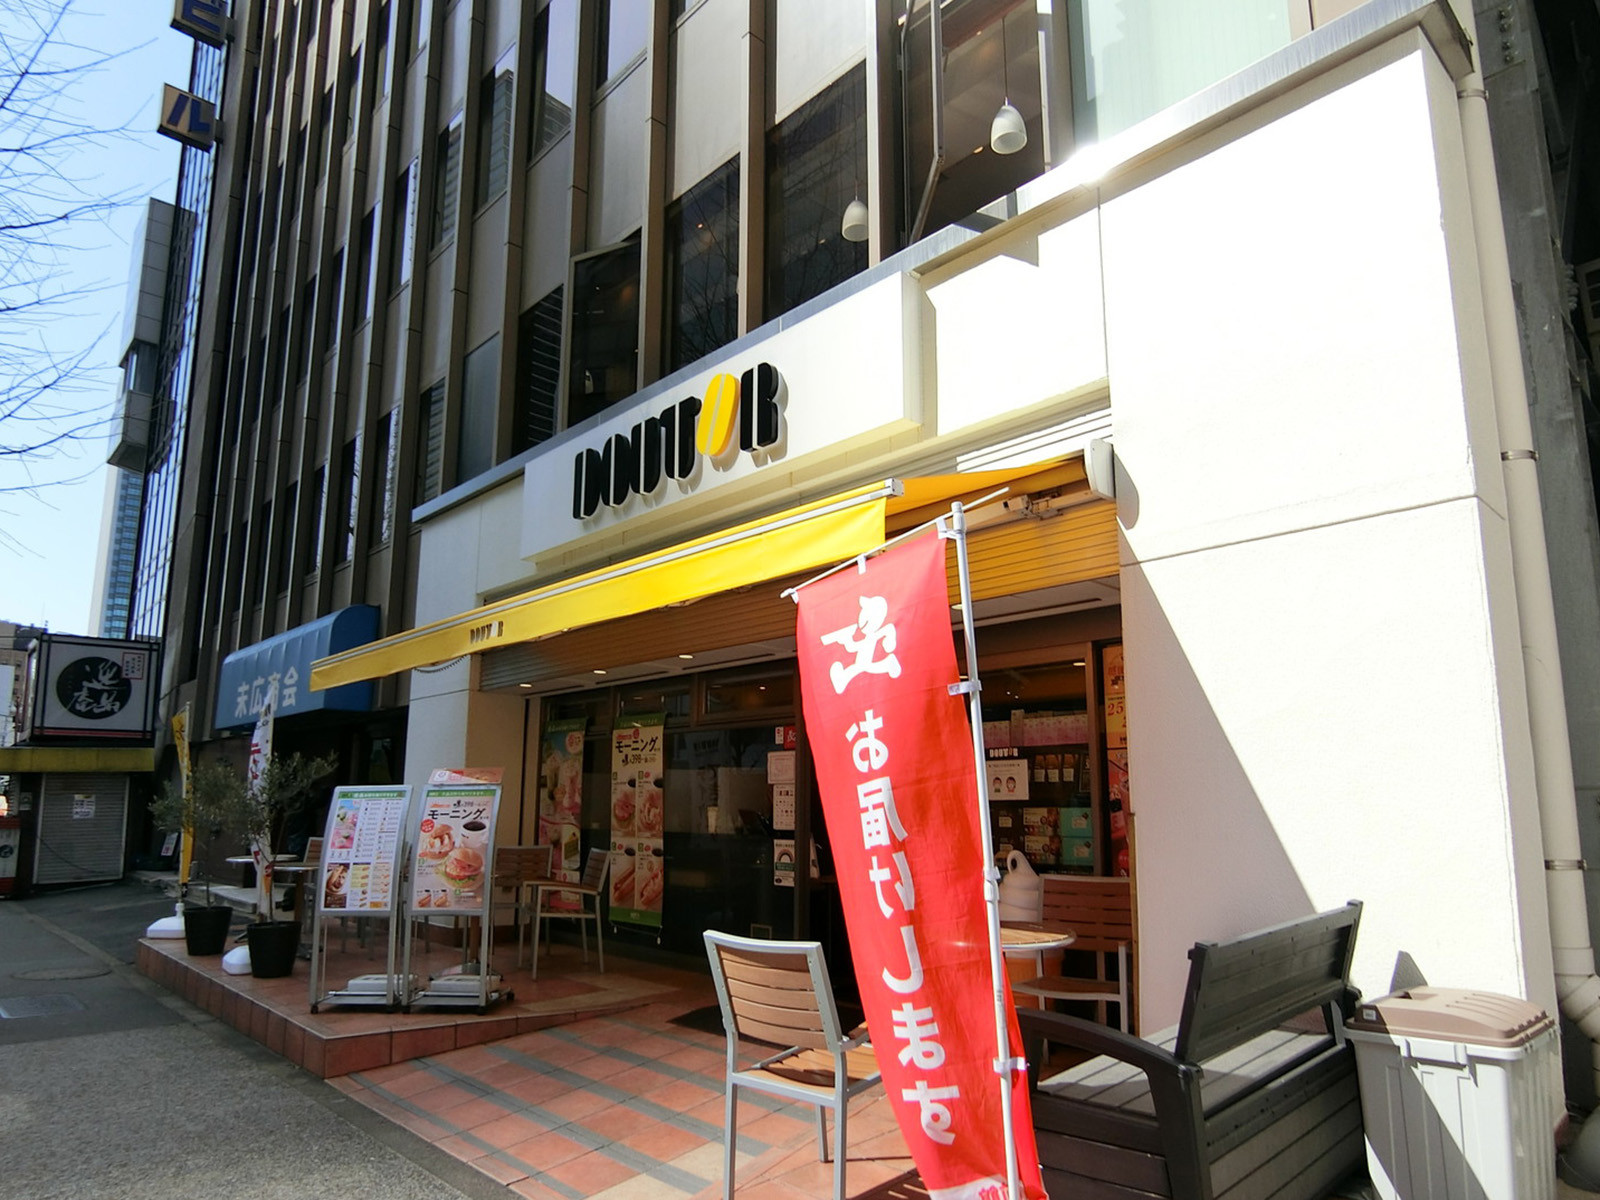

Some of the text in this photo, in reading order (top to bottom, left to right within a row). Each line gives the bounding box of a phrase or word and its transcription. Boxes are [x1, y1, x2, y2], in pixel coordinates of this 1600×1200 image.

[573, 362, 779, 520] DOUTOR
[615, 736, 658, 753] モーニング
[428, 808, 486, 820] モーニング
